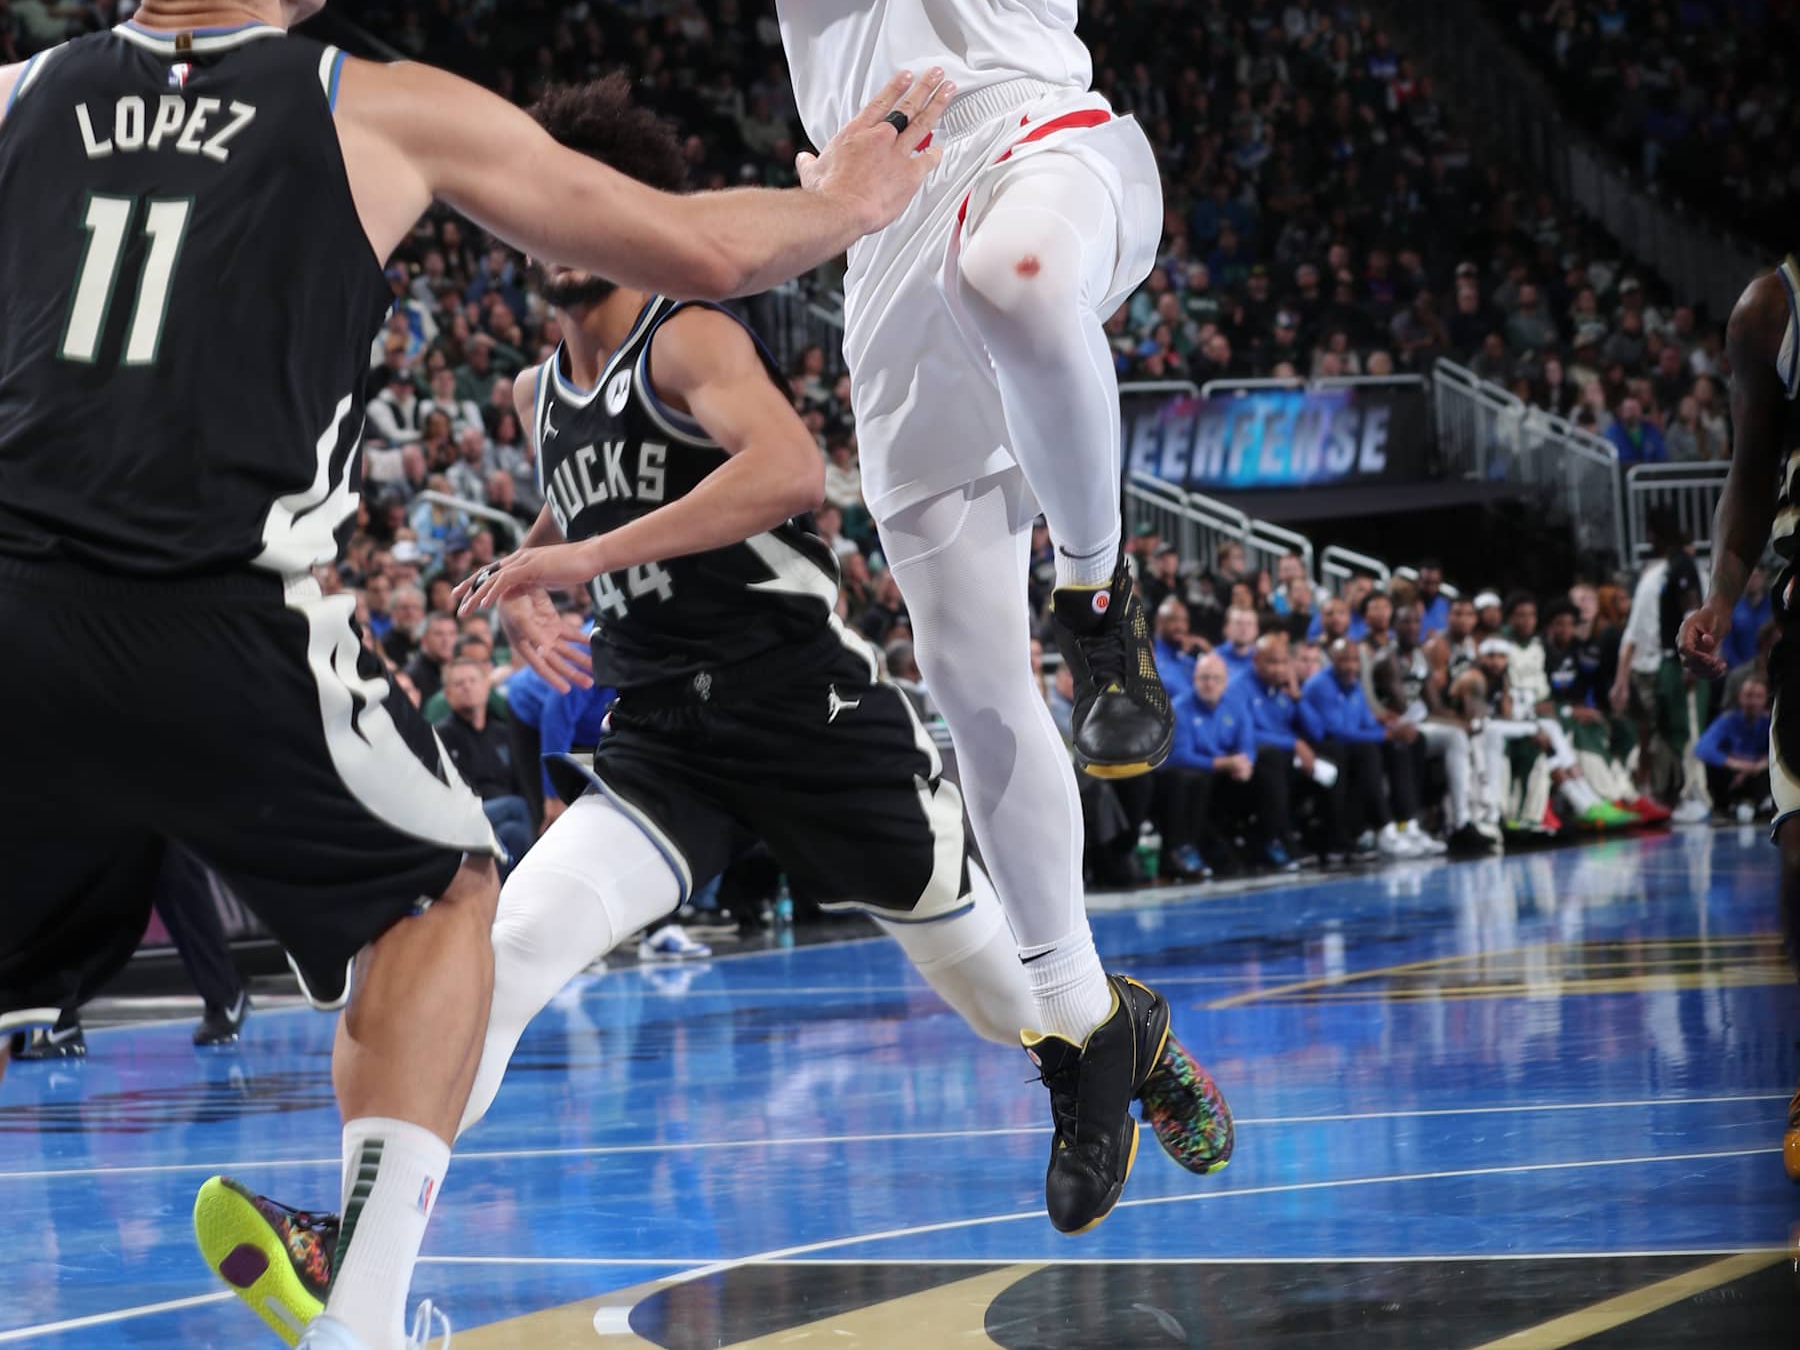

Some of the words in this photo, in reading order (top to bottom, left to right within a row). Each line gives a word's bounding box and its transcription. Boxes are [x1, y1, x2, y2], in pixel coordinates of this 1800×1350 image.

[75, 95, 257, 162] LOPEZ
[57, 190, 196, 364] 11
[1121, 406, 1391, 480] EERFENSE
[547, 441, 667, 538] BUCKS
